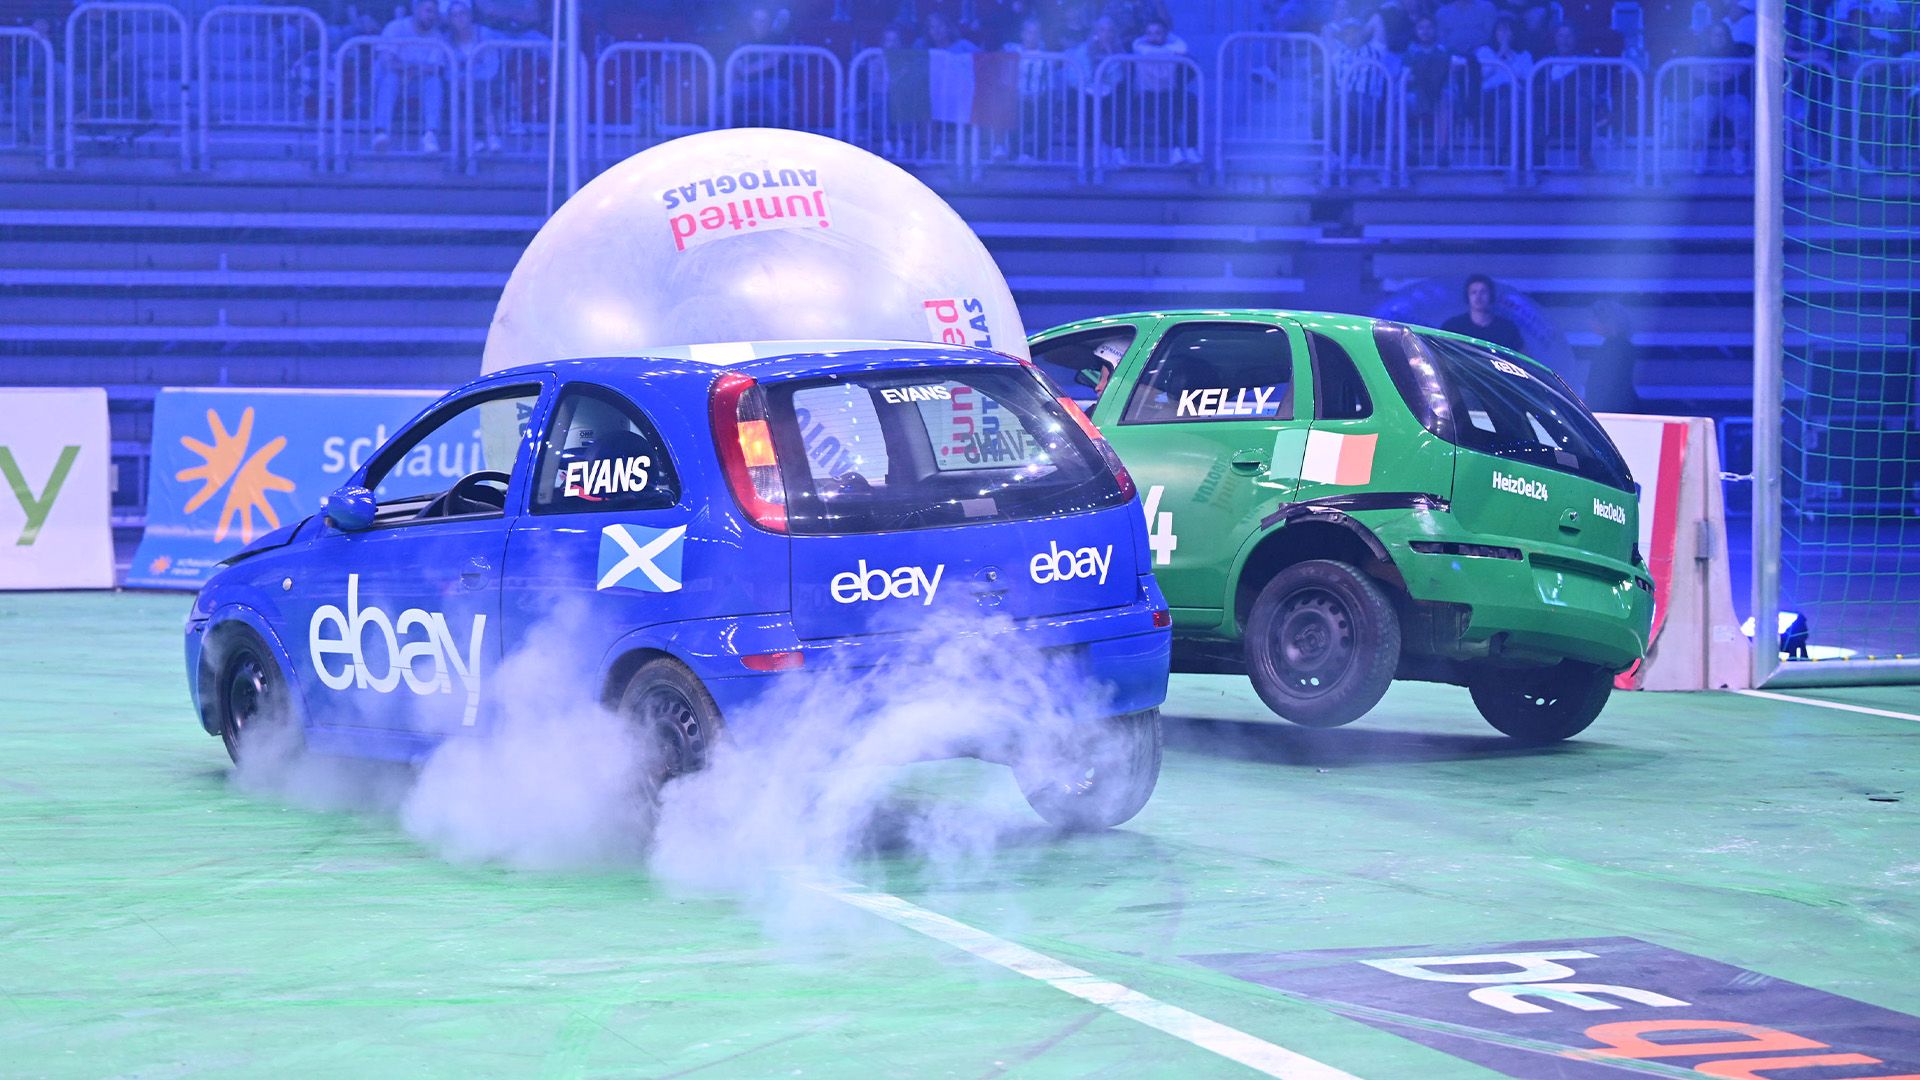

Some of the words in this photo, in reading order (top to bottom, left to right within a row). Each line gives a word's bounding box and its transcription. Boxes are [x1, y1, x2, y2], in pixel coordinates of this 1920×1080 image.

[662, 168, 817, 210] AUTOGLAS
[670, 190, 829, 251] junited
[1490, 359, 1529, 379] KELLY
[880, 385, 951, 404] EVANS
[1176, 386, 1275, 417] KELLY
[564, 455, 650, 497] EVANS
[1492, 470, 1548, 501] HeizOel24
[1593, 497, 1626, 525] HeizOel24
[830, 559, 945, 606] ebay
[1030, 540, 1113, 585] ebay
[309, 573, 487, 726] ebay
